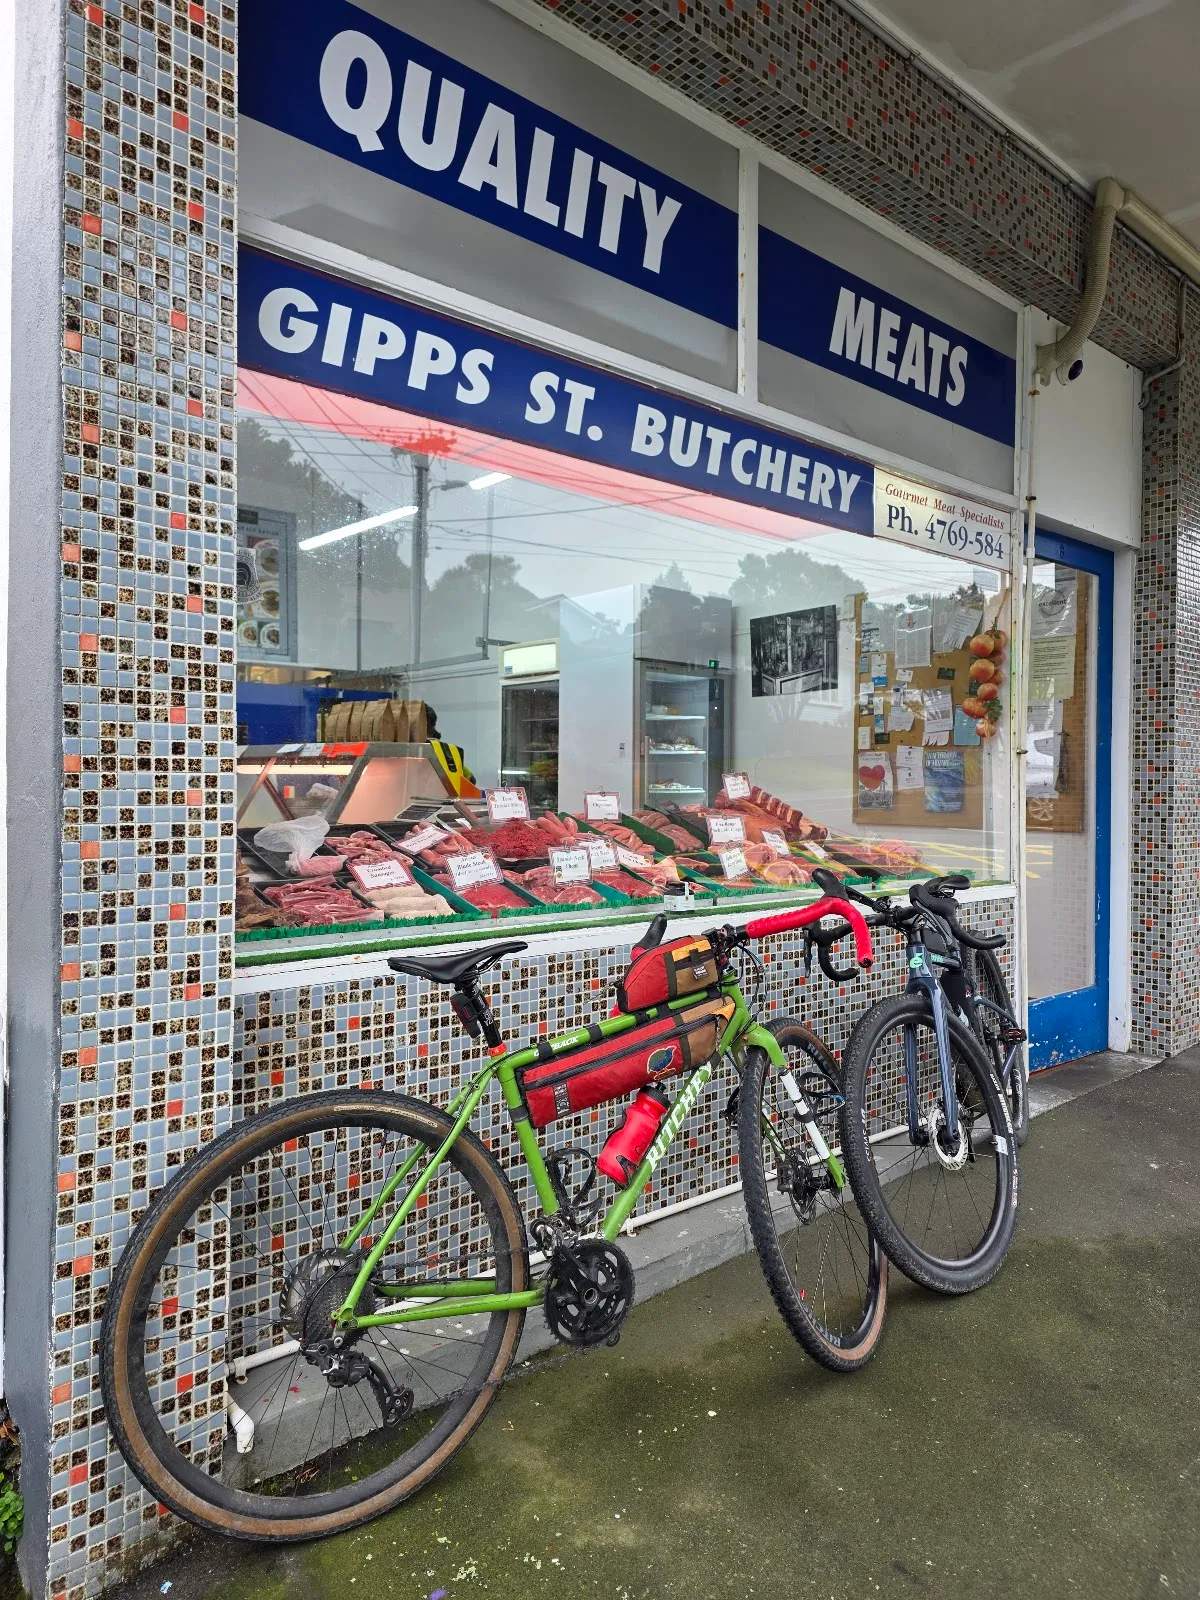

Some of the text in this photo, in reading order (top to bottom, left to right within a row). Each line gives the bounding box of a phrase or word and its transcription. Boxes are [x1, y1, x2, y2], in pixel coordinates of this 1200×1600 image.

[319, 30, 968, 406] QUALITY MEATS
[258, 288, 861, 513] GIPPS ST. BUTCHERY
[885, 483, 1005, 530] Gourmet Meat Specialists
[886, 503, 1004, 559] Ph. 4769-584
[1038, 599, 1067, 607] excellent
[646, 1061, 711, 1172] RITCHEY
